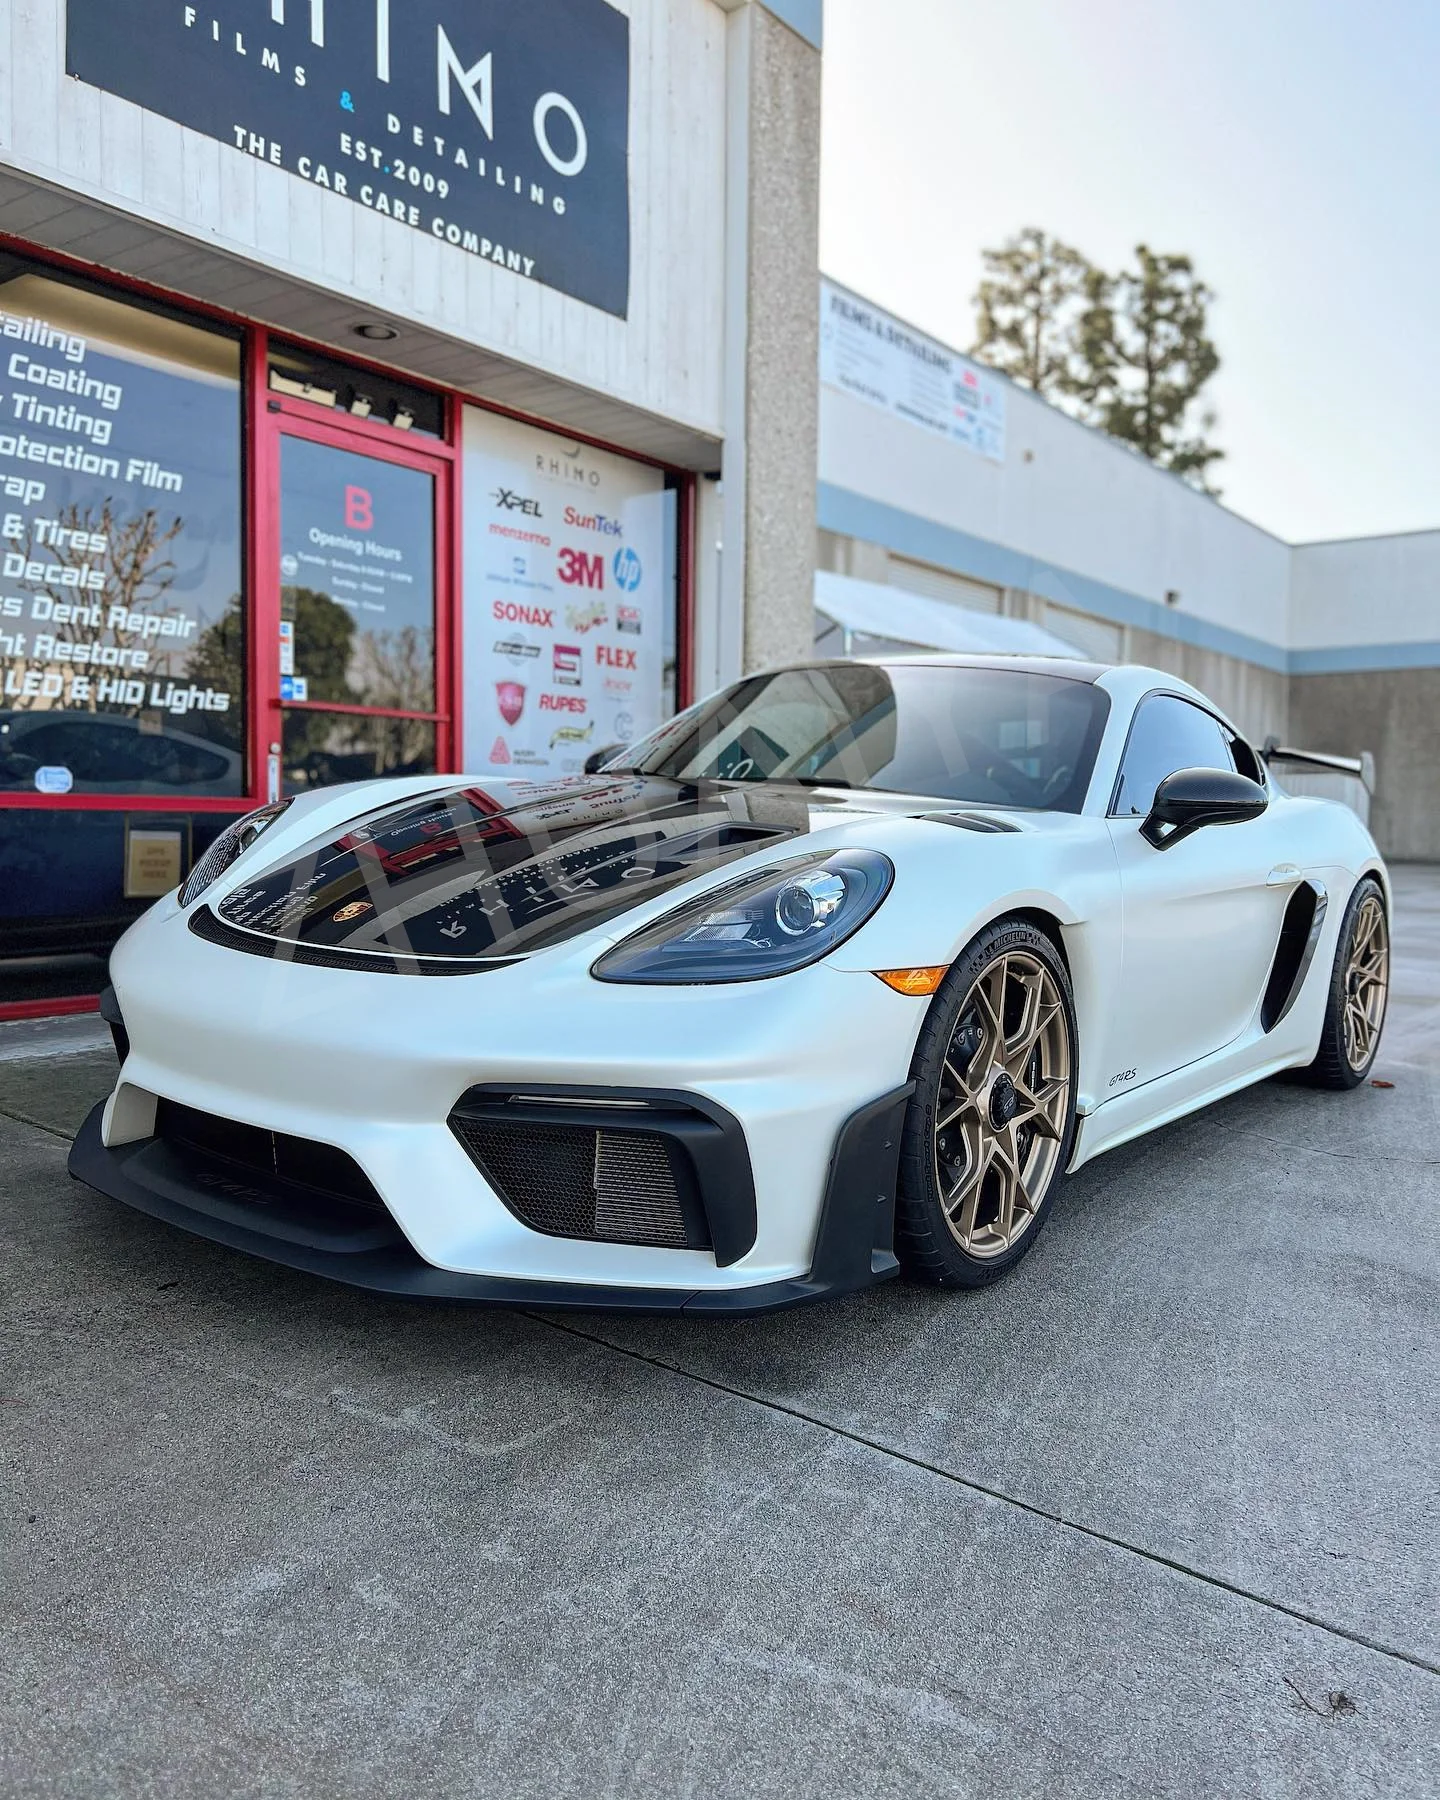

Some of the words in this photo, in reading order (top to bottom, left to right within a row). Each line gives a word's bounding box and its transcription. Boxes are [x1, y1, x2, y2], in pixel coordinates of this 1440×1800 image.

[184, 6, 308, 87] FILMS
[339, 91, 355, 113] &
[387, 113, 567, 215] DETAILING
[340, 133, 450, 199] EST.2009
[233, 125, 283, 165] THE
[298, 157, 348, 196] CAR
[360, 185, 421, 226] CARE
[432, 217, 536, 278] COMPANY
[8, 353, 122, 411] Coating
[12, 392, 112, 446] Tinting
[125, 458, 184, 493] Film
[343, 484, 375, 531] B
[497, 488, 543, 518] XPEL
[564, 506, 624, 538] SunTek
[2, 513, 25, 540] &
[34, 517, 108, 553] Tires
[309, 527, 364, 556] Opening
[365, 540, 402, 562] Hours
[2, 552, 107, 591] Decals
[557, 548, 604, 590] 3M
[612, 547, 642, 592] hp
[31, 595, 102, 627] Dent
[107, 605, 197, 639] Repair
[493, 601, 553, 628] SONAX
[33, 633, 149, 668] Restore
[596, 645, 637, 671] FLEX
[4, 670, 64, 698] LED
[71, 675, 91, 701] &
[97, 679, 146, 705] HID
[150, 682, 231, 715] Lights
[539, 693, 588, 714] RUPES
[994, 931, 1027, 949] MICHELIN
[1108, 1068, 1137, 1087] GT4RS
